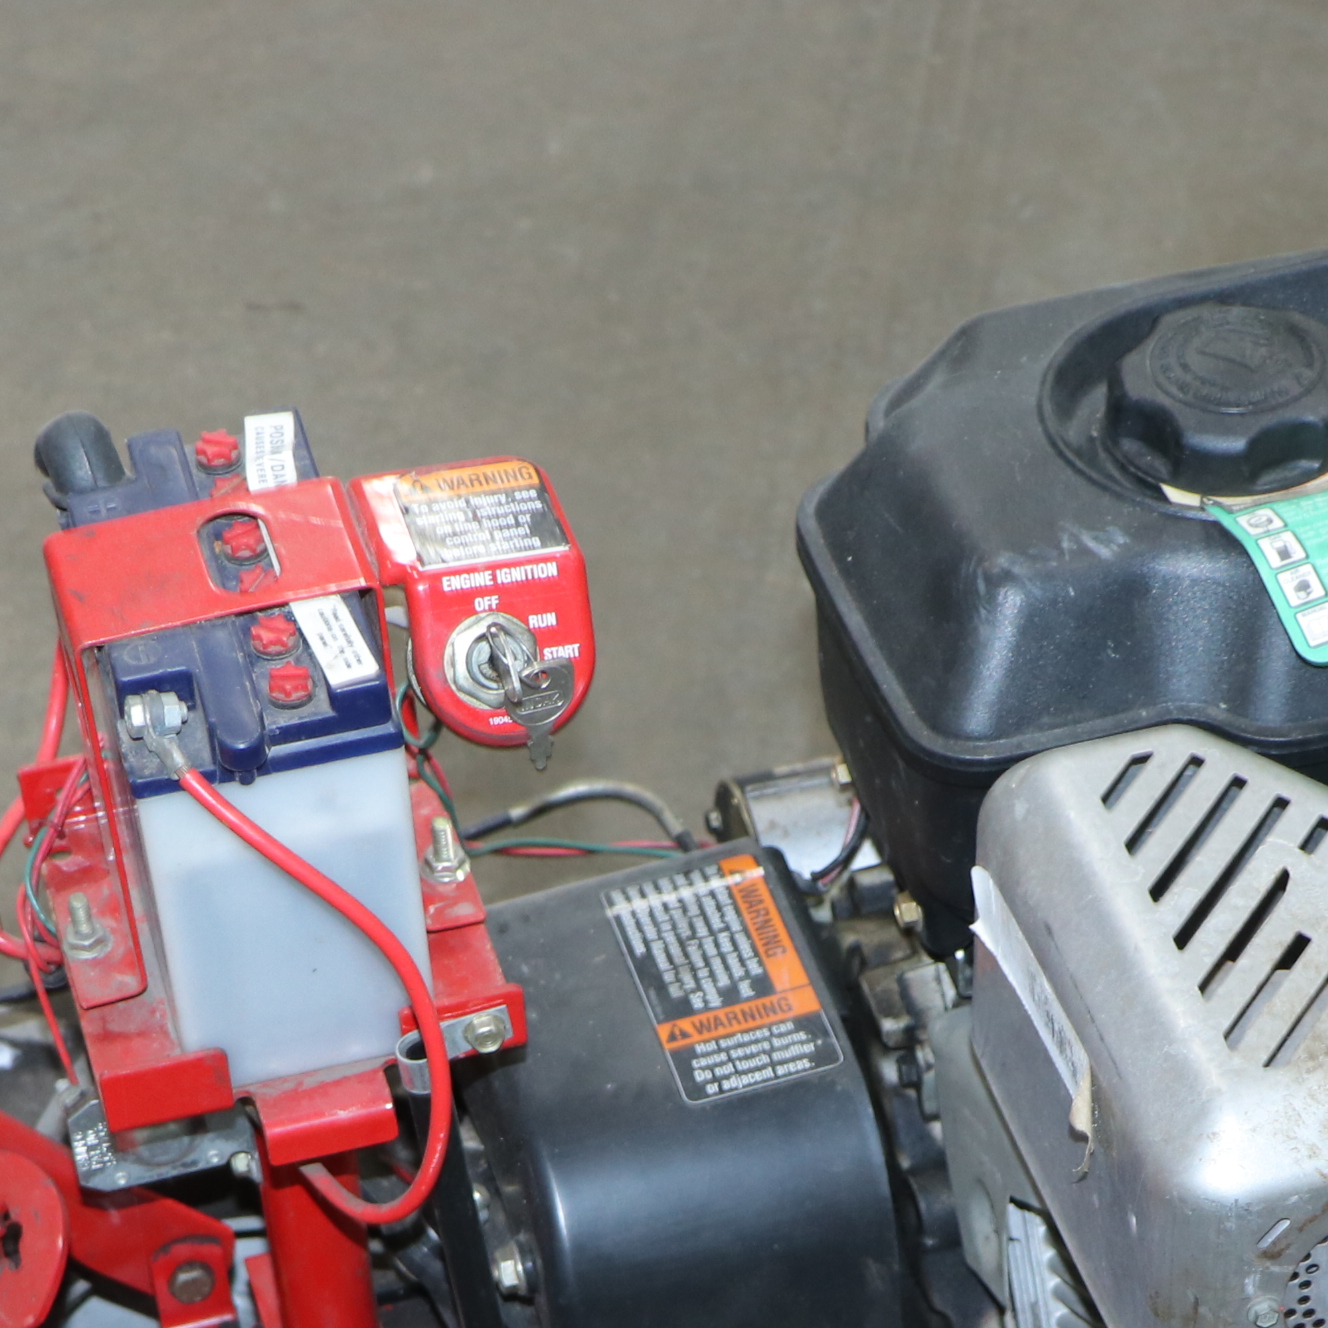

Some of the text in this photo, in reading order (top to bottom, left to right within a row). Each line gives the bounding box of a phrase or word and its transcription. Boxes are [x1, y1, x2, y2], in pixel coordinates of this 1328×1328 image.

[438, 465, 533, 491] WARNING
[431, 498, 466, 512] avoid
[515, 489, 537, 499] see
[483, 515, 515, 528] hood
[518, 514, 531, 524] or
[446, 530, 490, 546] control
[494, 525, 530, 540] panel
[442, 562, 558, 591] ENGINE IGNITION
[474, 596, 499, 611] OFF
[529, 613, 556, 628] RUN
[544, 644, 580, 660] START
[738, 883, 787, 958] WARNING
[688, 992, 705, 1010] See
[691, 996, 793, 1035] WARNING
[692, 1030, 811, 1068] cause severe burns.
[694, 1021, 794, 1055] Hot surfaces can
[693, 1042, 815, 1083] Do not touch muffler
[705, 1058, 815, 1095] or adjacent areas.
